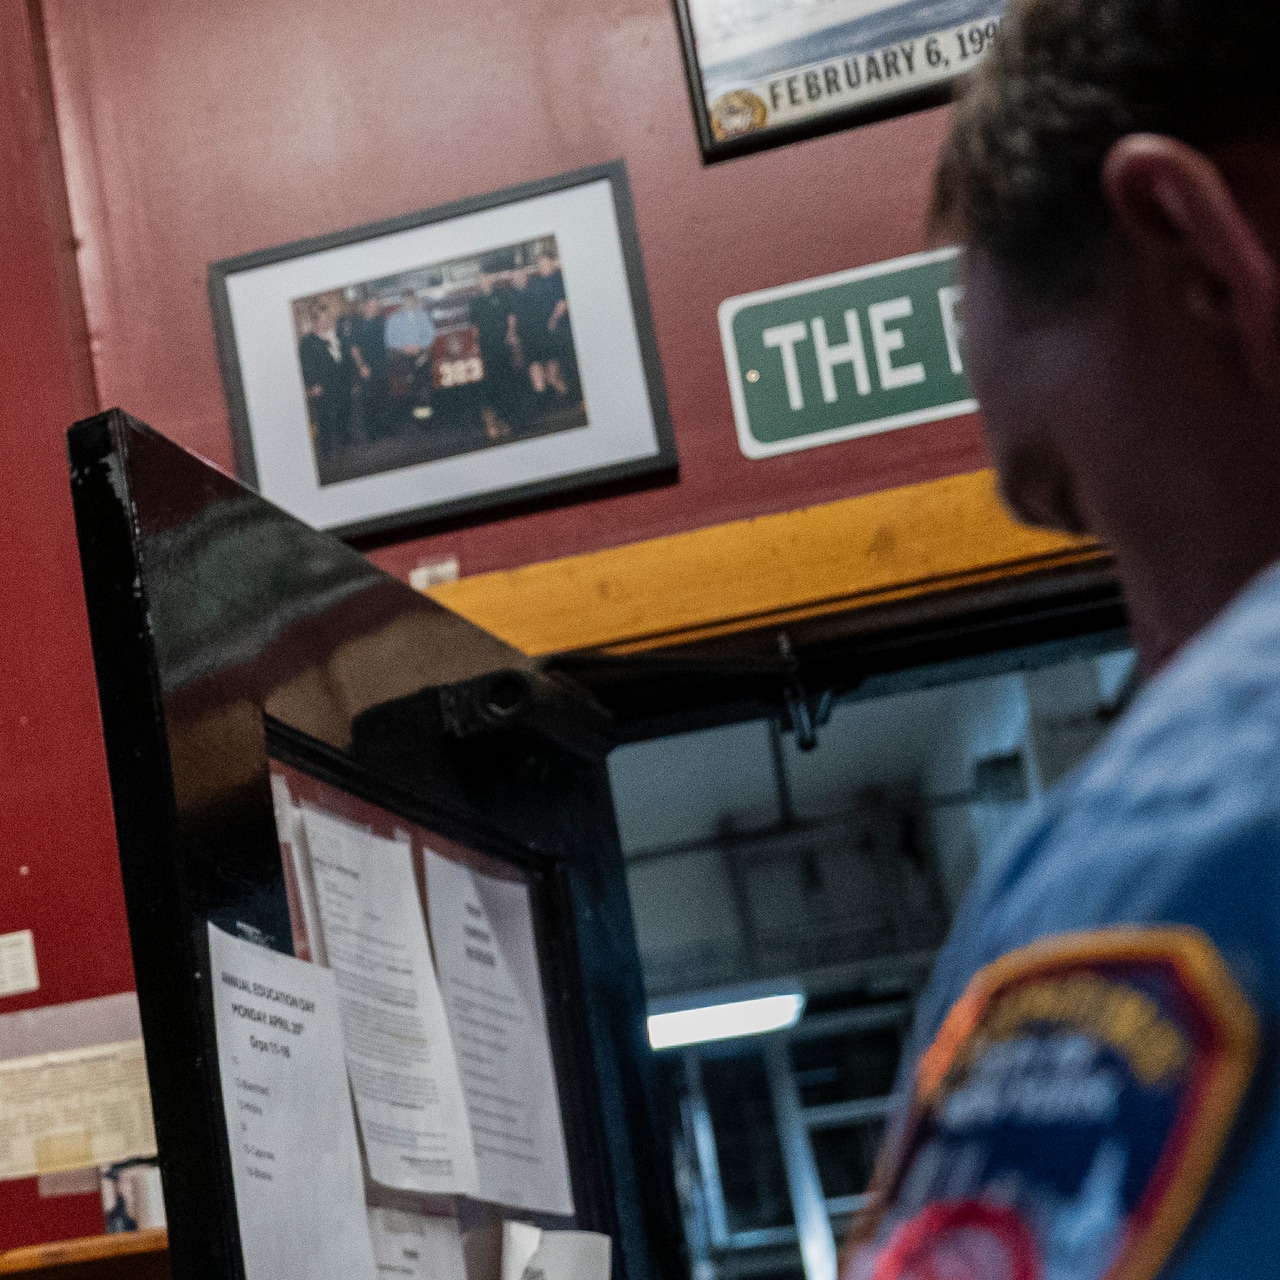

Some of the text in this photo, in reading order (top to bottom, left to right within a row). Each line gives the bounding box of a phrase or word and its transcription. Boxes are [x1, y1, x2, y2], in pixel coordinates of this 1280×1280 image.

[767, 47, 916, 111] FEBRUARY
[925, 38, 951, 71] 6,
[762, 297, 926, 411] THE
